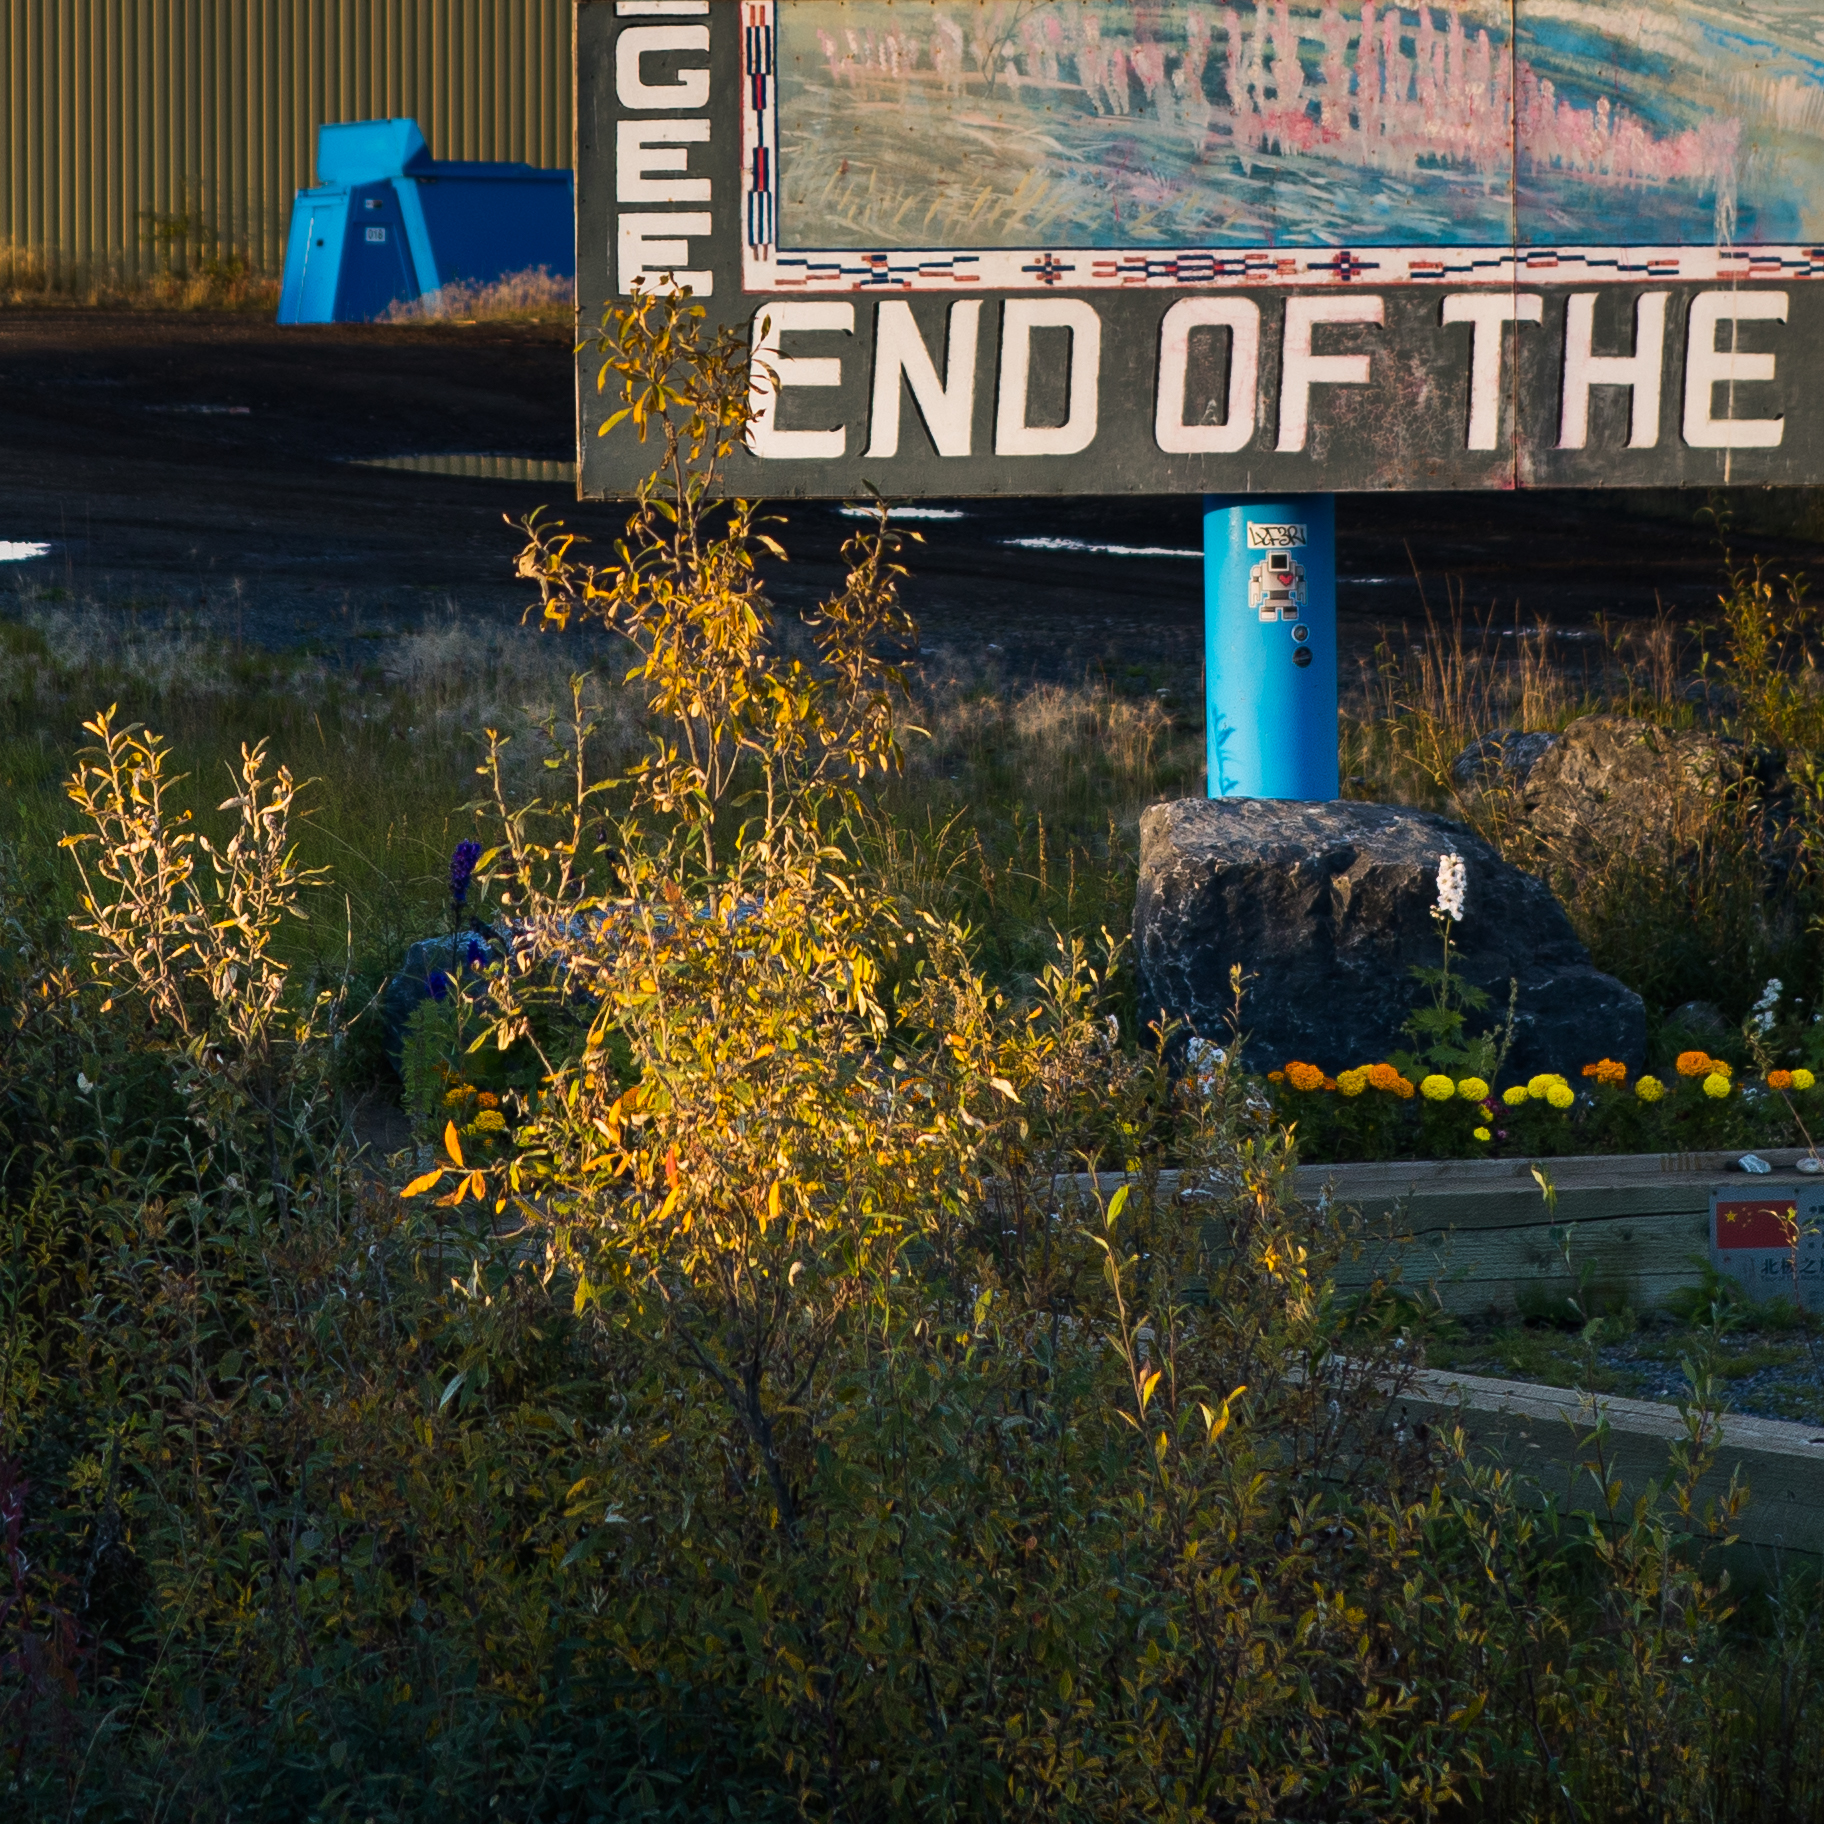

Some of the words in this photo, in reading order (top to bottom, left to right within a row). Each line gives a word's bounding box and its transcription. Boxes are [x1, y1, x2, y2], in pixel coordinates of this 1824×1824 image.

[748, 298, 1101, 460] END
[1155, 294, 1385, 454] OF
[1440, 290, 1789, 450] THE
